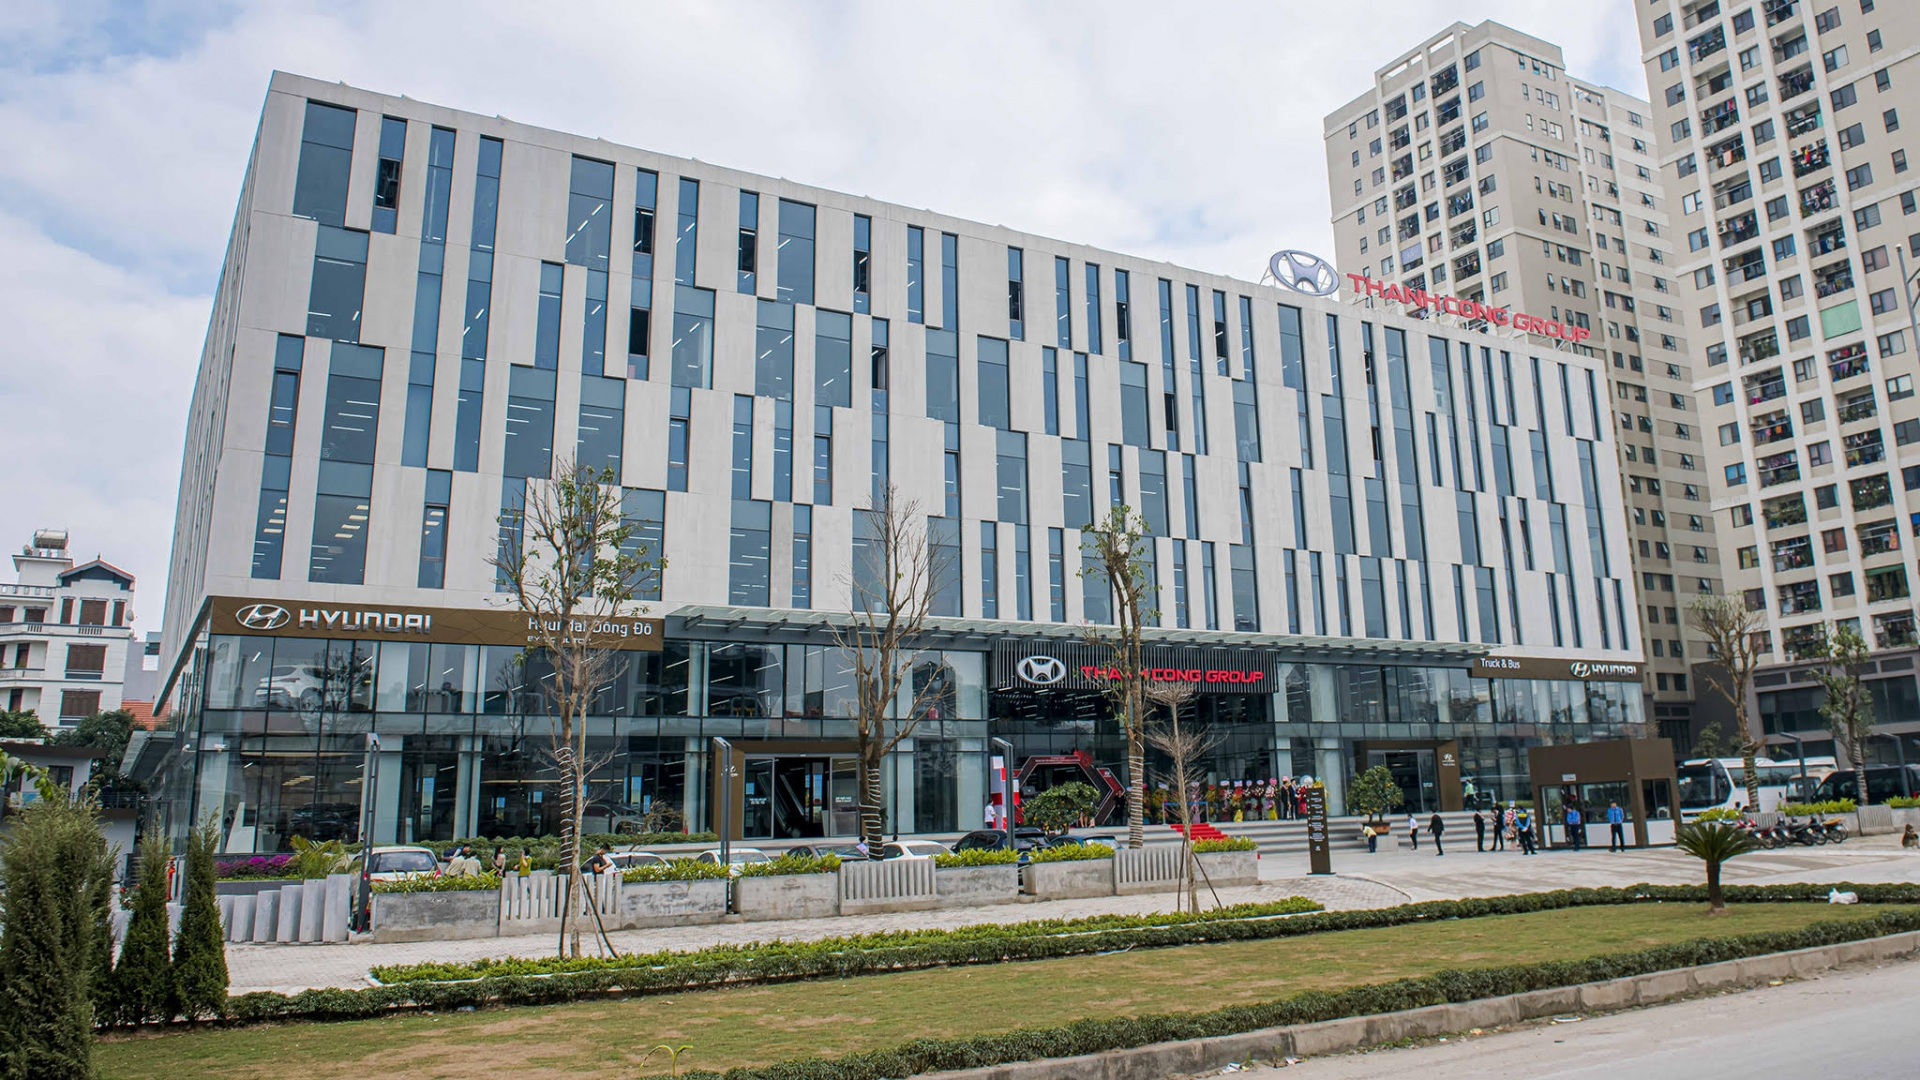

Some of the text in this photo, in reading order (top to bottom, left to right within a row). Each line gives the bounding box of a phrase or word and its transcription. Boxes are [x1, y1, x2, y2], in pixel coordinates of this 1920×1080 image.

[1347, 272, 1591, 343] THANH CONG GROUP
[299, 608, 432, 633] HYUNDAI
[633, 621, 653, 635] Đô
[1480, 658, 1521, 669] Truck & Bus
[1592, 664, 1637, 676] HYUNDAI
[1080, 665, 1265, 683] THA CONG GROUP
